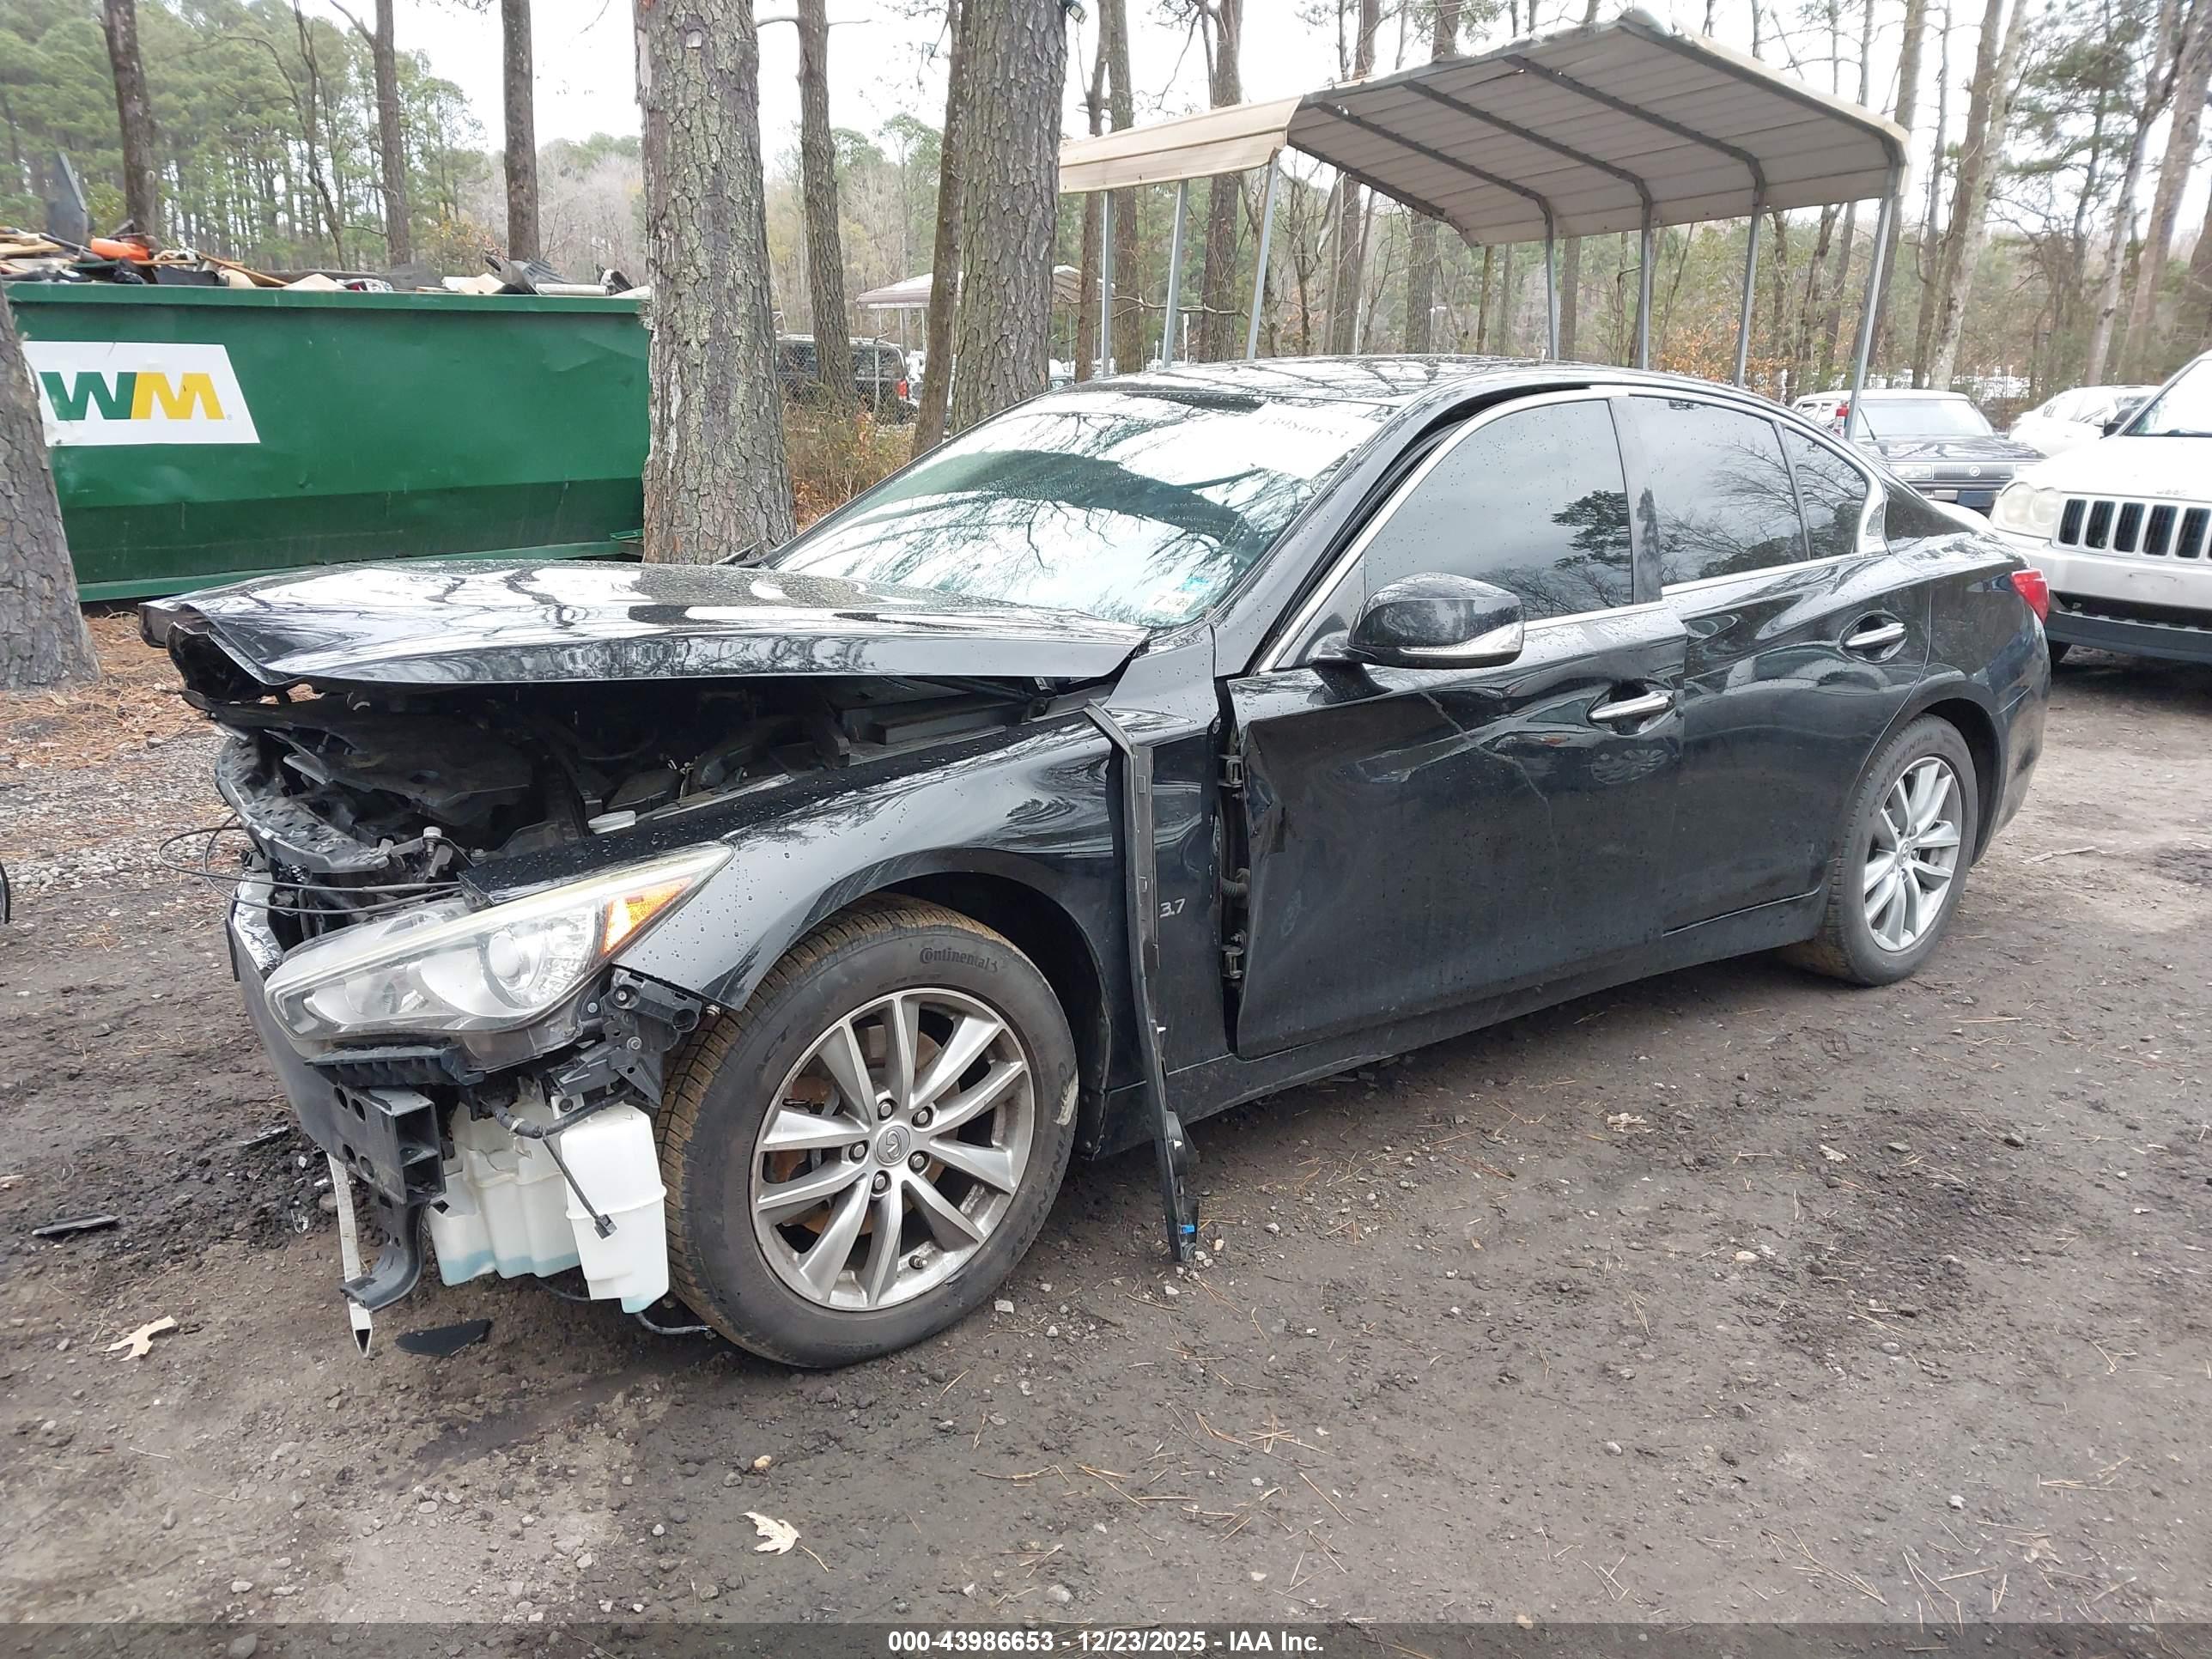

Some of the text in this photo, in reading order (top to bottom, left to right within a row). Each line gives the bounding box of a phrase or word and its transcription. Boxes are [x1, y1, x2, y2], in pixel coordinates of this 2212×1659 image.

[39, 371, 226, 421] WM
[1159, 898, 1186, 919] 3.7
[919, 947, 991, 970] Continental
